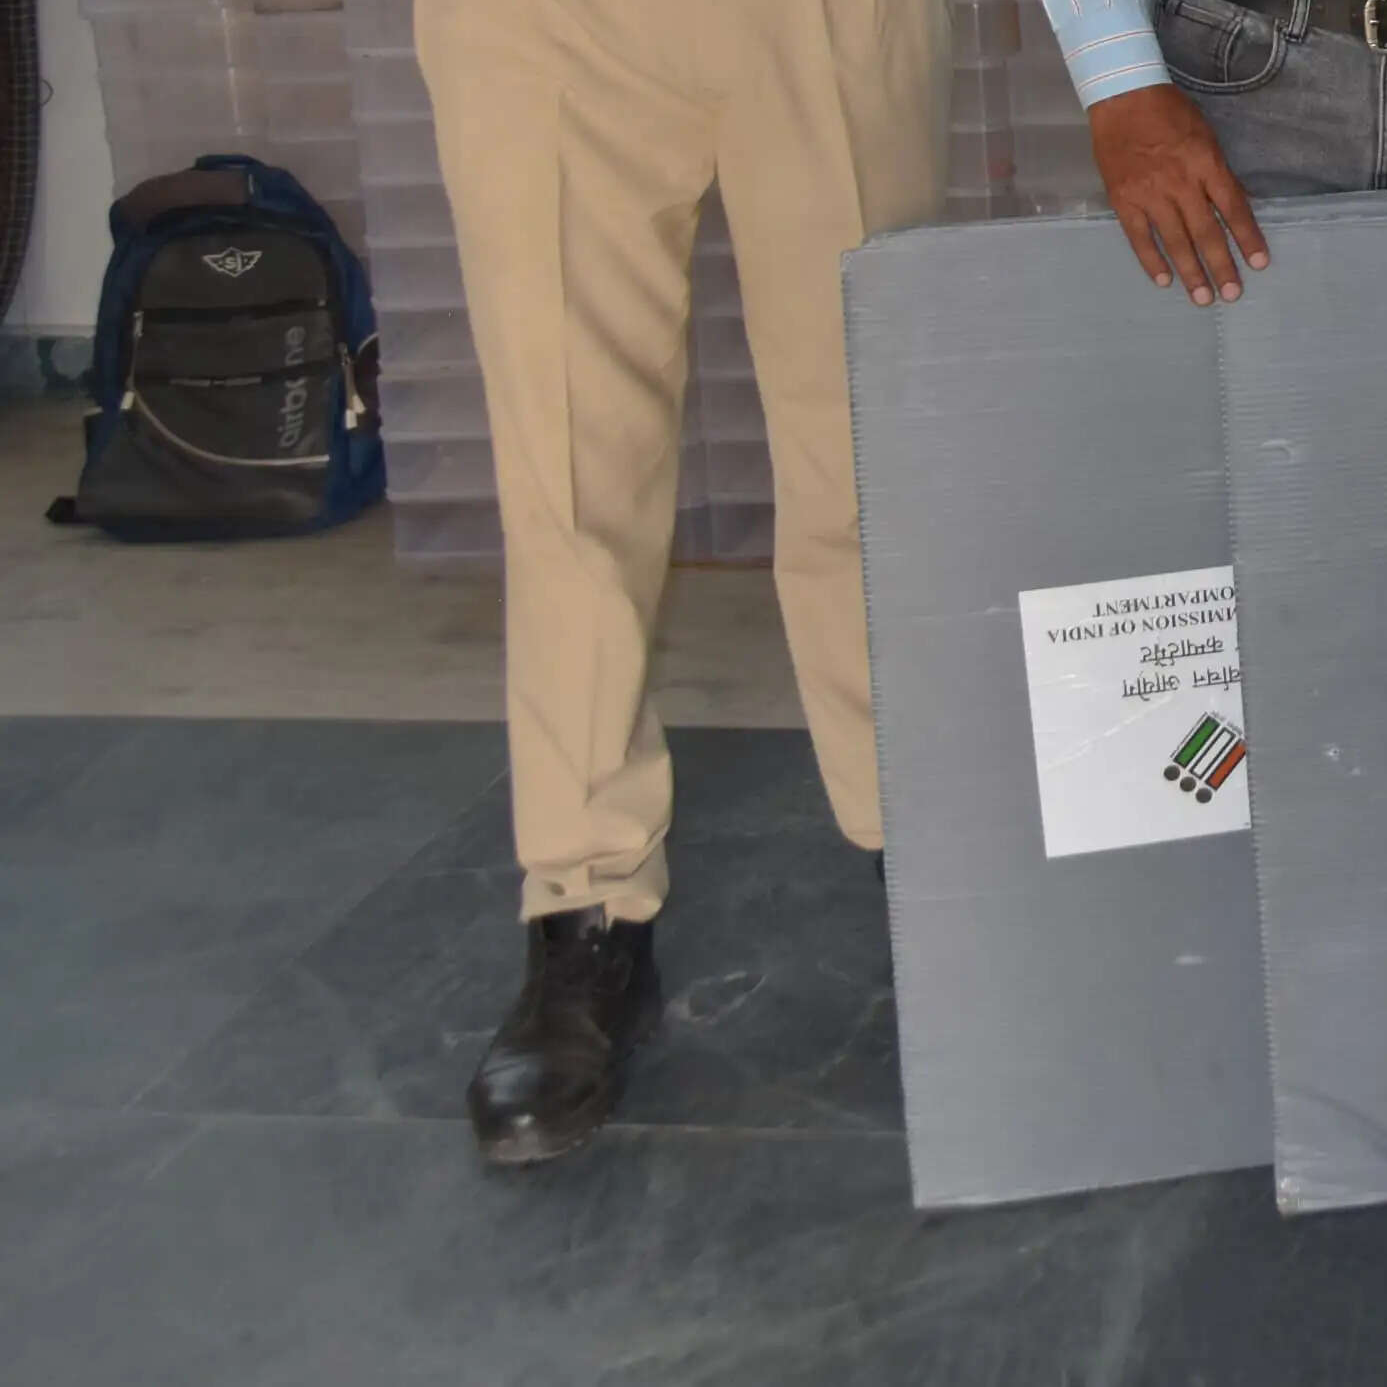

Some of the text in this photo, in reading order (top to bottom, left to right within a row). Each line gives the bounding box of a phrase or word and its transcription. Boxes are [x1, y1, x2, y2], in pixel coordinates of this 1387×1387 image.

[1092, 585, 1237, 619] OMPARTMENT
[1047, 624, 1105, 644] INDIA
[1108, 620, 1137, 637] OF
[1121, 674, 1181, 701] आयोग
